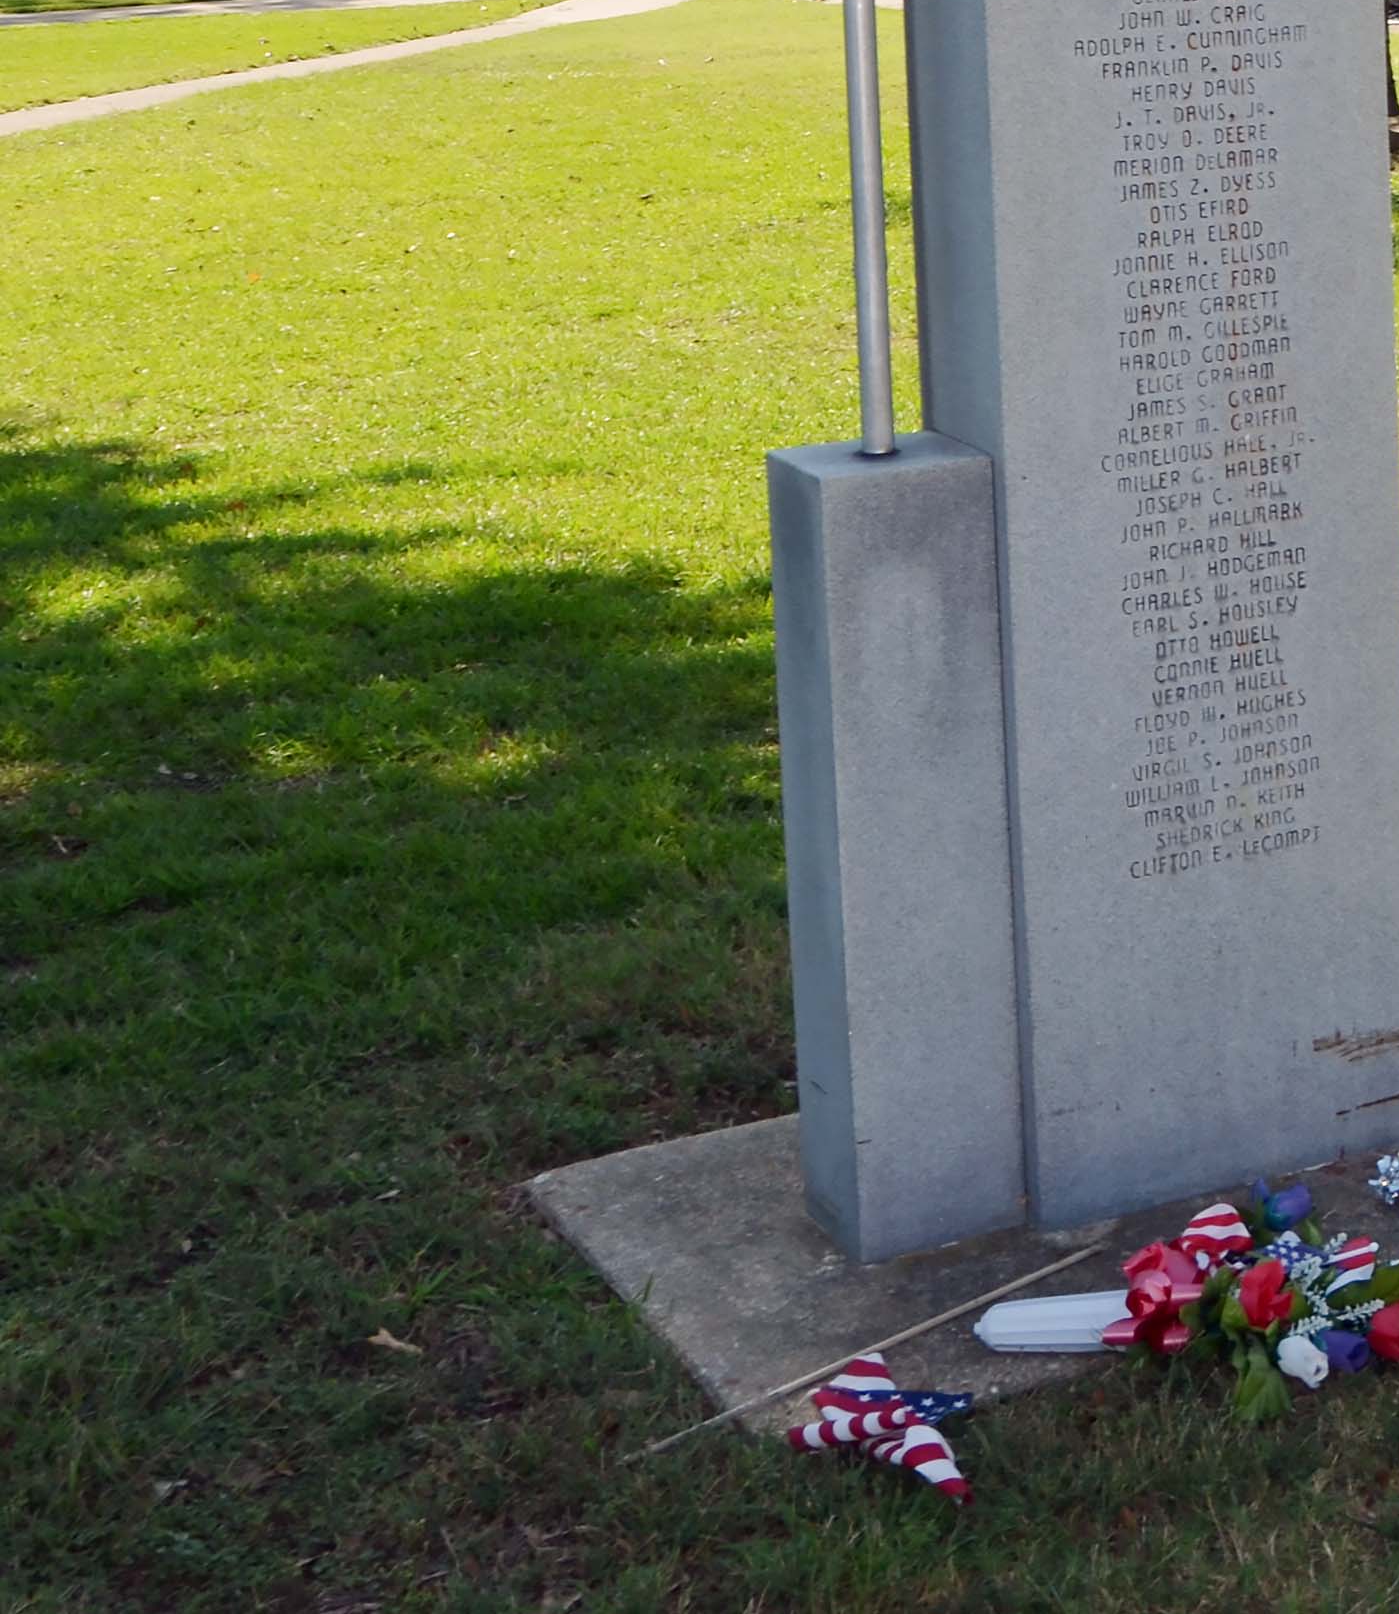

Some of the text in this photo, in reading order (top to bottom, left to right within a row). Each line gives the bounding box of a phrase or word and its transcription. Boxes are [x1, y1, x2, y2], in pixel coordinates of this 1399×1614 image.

[1132, 77, 1255, 102] HENRY DAVIS
[1121, 171, 1275, 202] JAMES Z. DYESS
[1151, 198, 1248, 224] OTIS EFIRD
[1138, 221, 1263, 249] RALPH ELROD
[1113, 241, 1288, 276] JONNIE H. ELLISON
[1127, 267, 1275, 299] CLARENCE FORD
[1124, 291, 1279, 323] WAYNE GARRETT
[1120, 337, 1290, 371] HAROLD GOODMAN
[1197, 362, 1273, 388] GRAHAM
[1117, 470, 1180, 493] MILLER
[1225, 453, 1301, 478] HALBERT
[1150, 529, 1277, 561] RICHARD HILL
[1132, 595, 1297, 636] EARL S. HOUSLEY
[1156, 625, 1280, 661] OTTO HOWELL
[1154, 647, 1283, 683] CONNIE HUELL
[1152, 670, 1288, 707] VERNON HUELL
[1156, 807, 1295, 851] SHEDRICK KING
